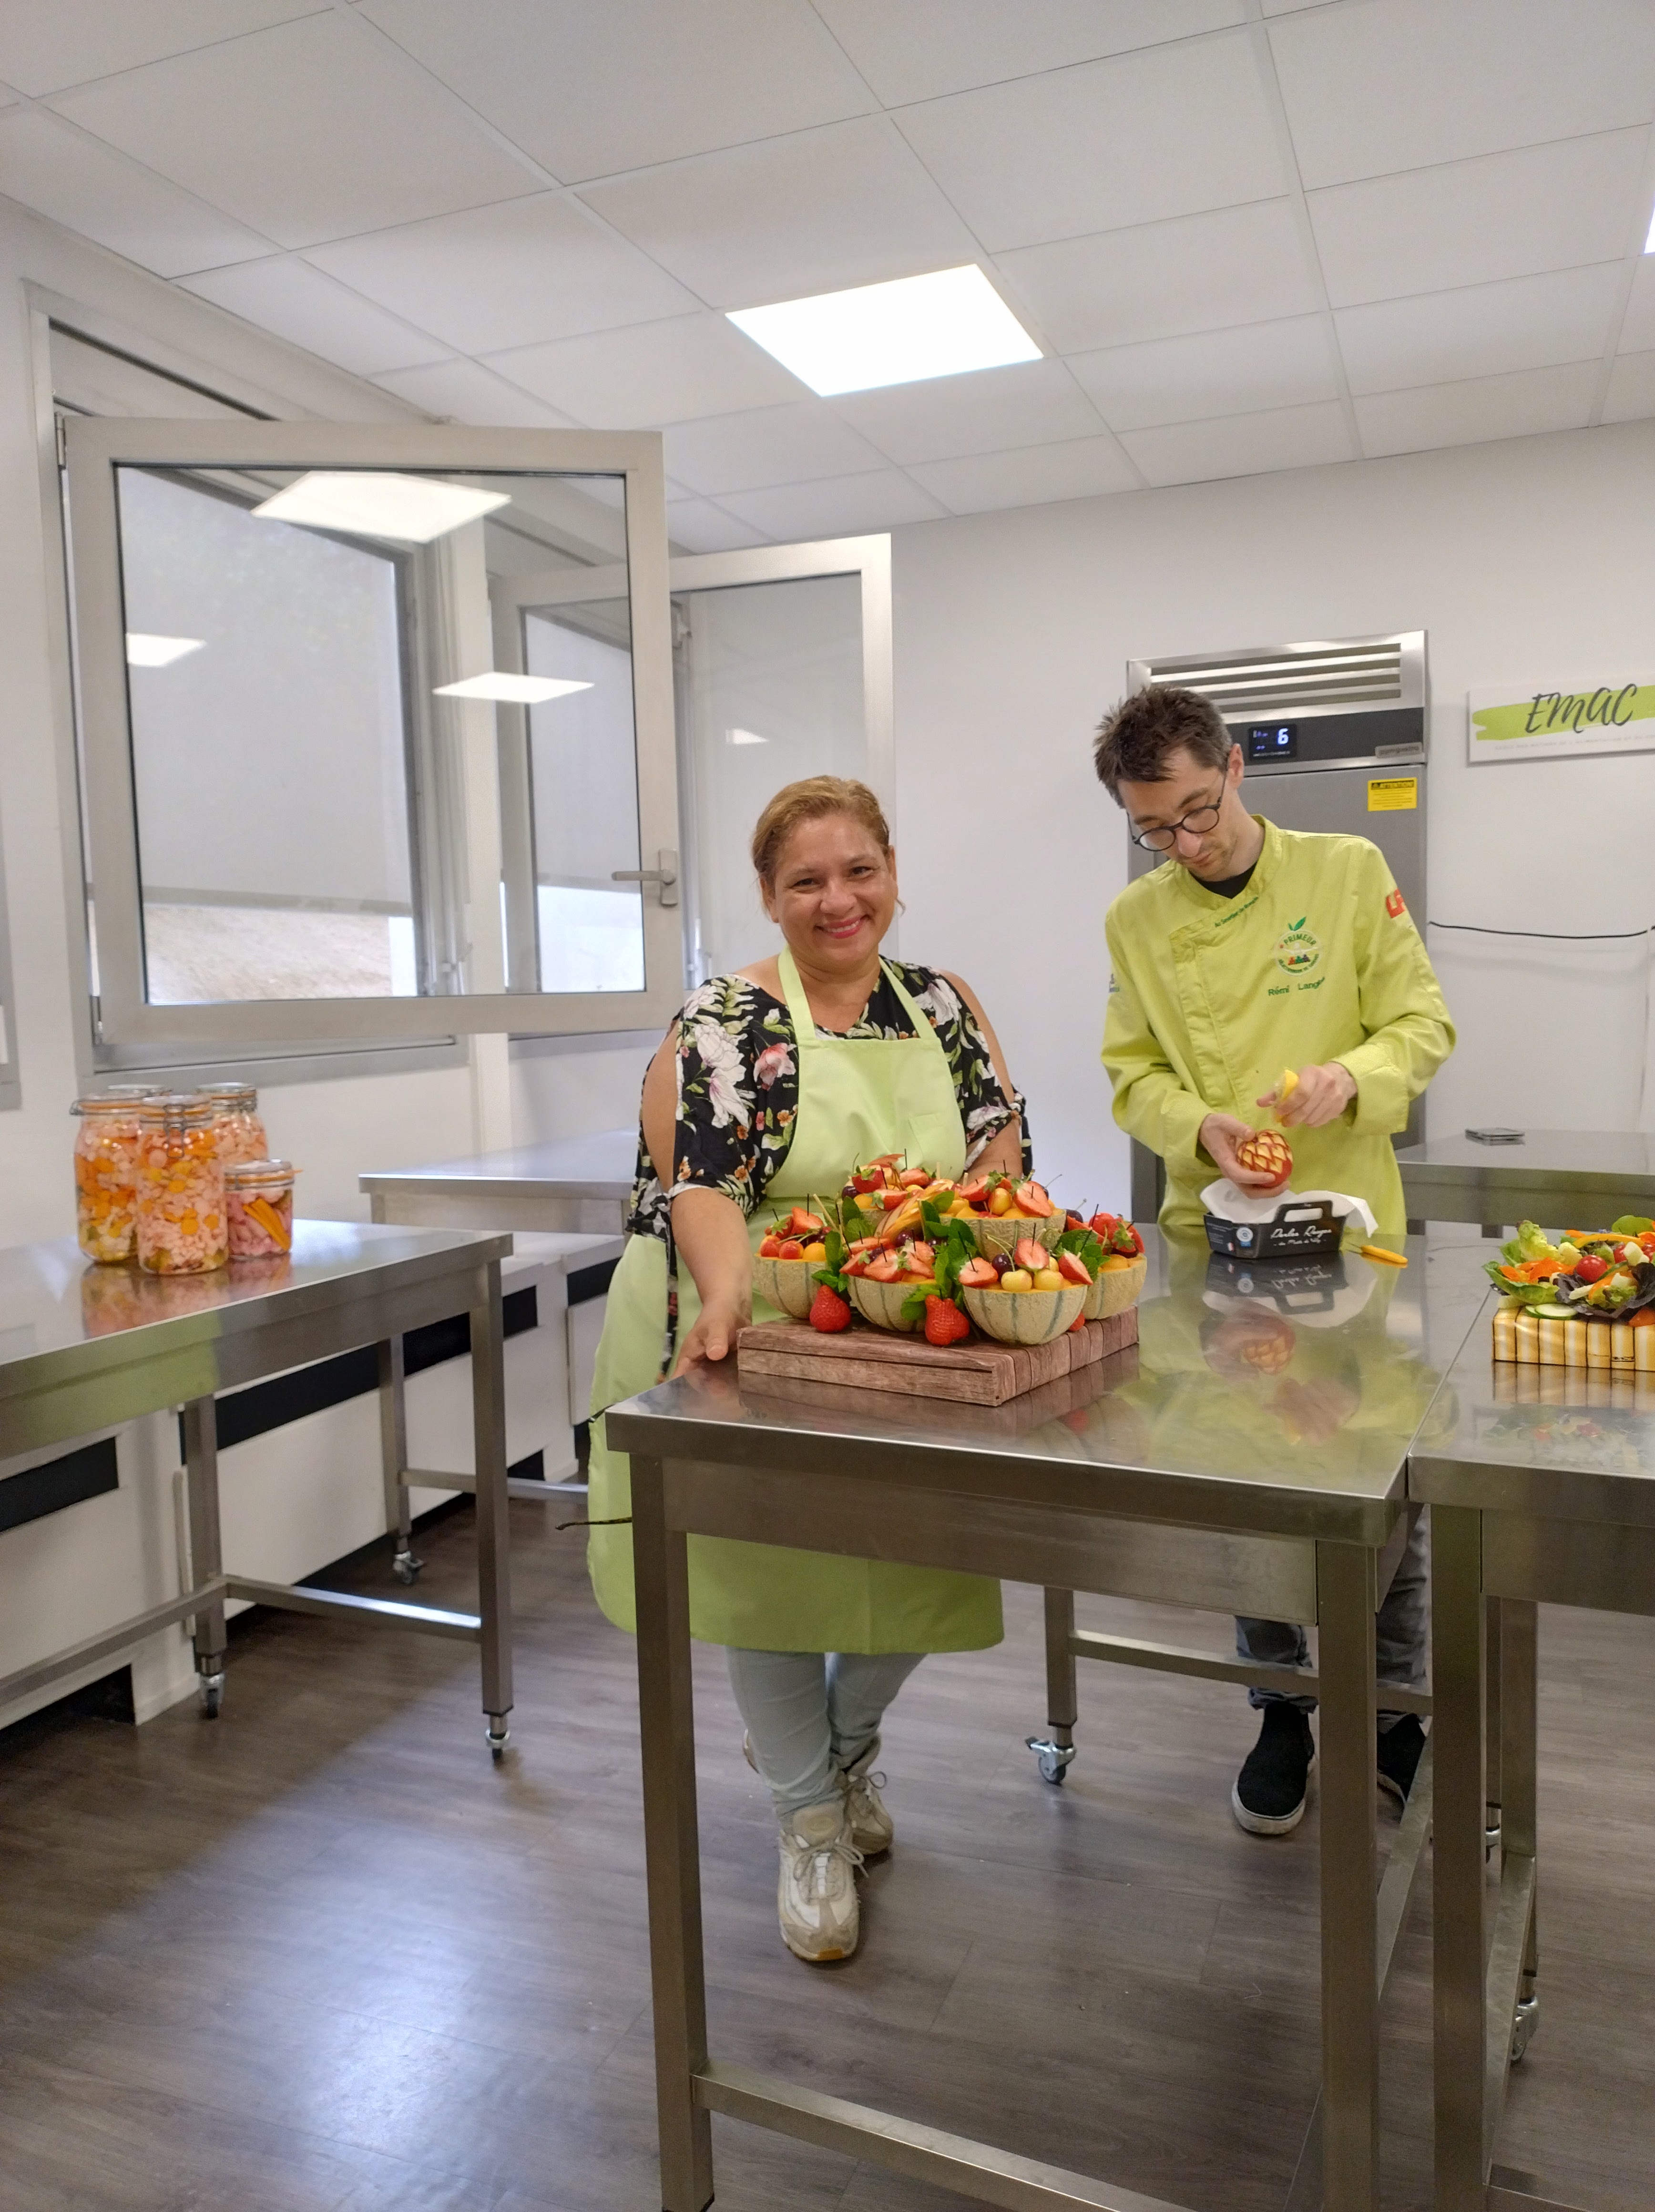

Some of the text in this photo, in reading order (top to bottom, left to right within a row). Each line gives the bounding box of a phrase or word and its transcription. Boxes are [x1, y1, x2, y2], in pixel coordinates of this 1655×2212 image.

[1277, 728, 1288, 745] 6
[1283, 933, 1317, 946] PRIMEUR
[1268, 985, 1289, 996] Rémi
